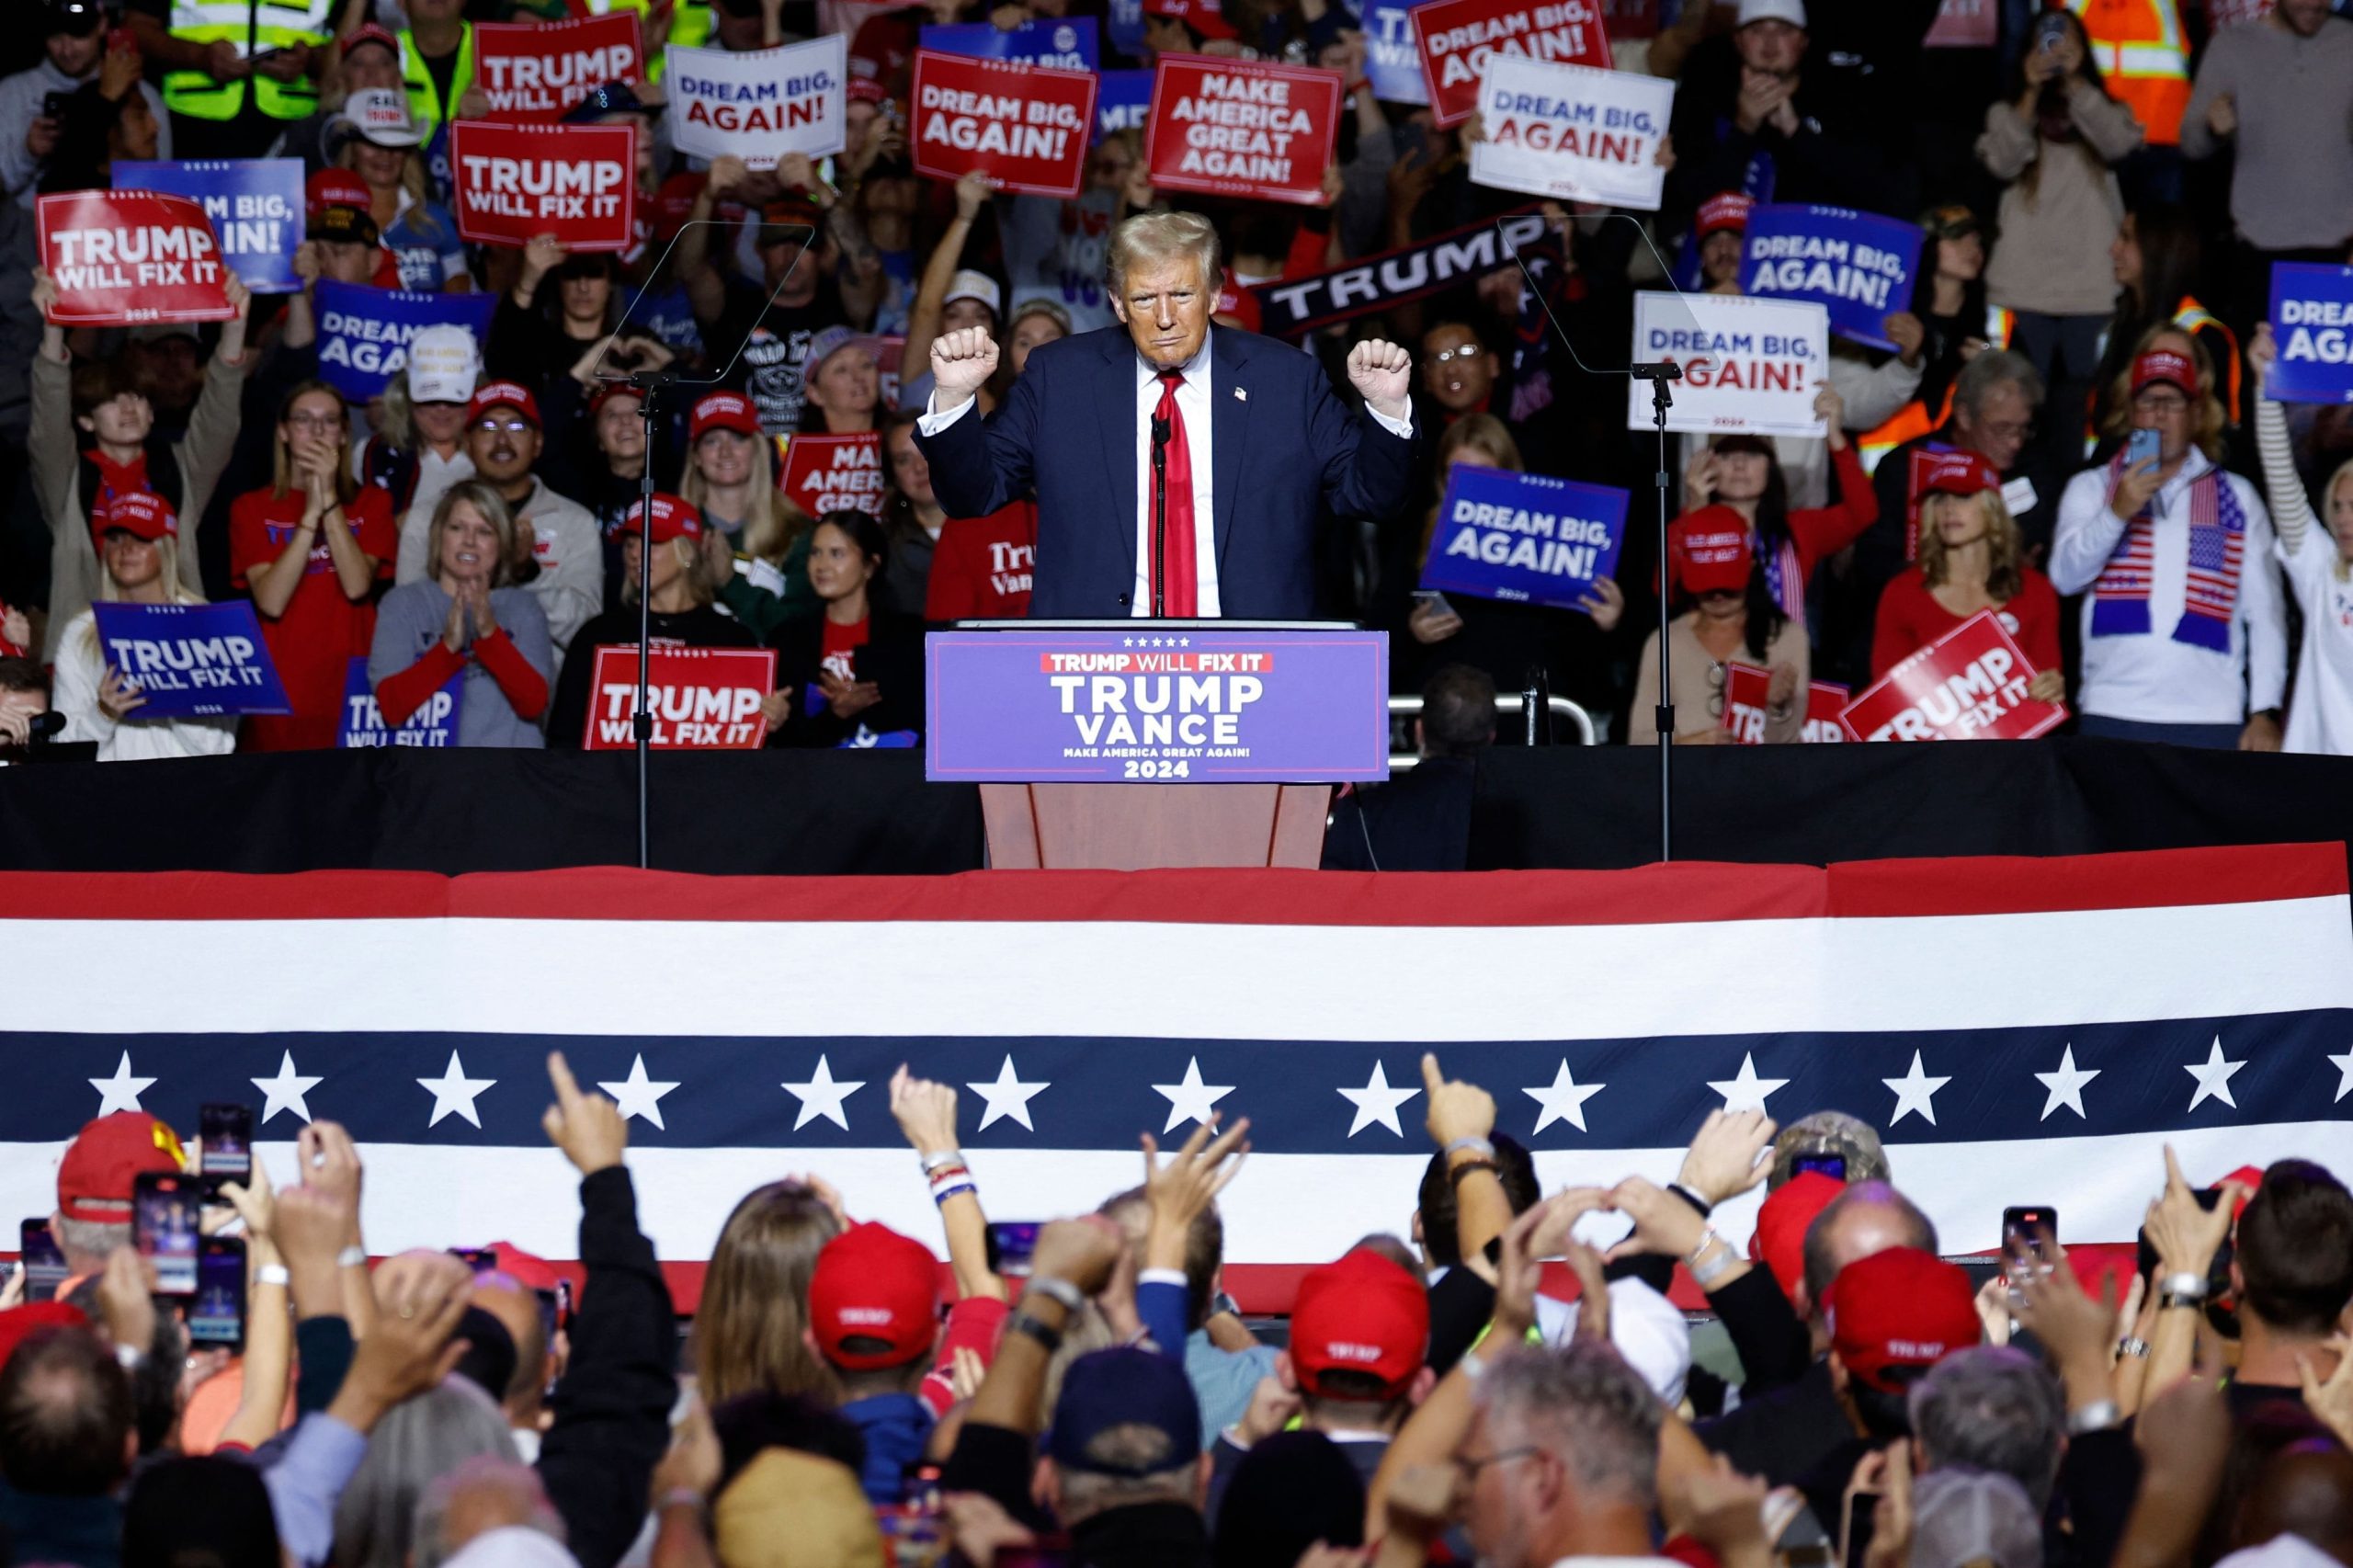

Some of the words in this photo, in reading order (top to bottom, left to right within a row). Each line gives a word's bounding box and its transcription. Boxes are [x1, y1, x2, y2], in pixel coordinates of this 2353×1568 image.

[1427, 10, 1531, 58] DREAM
[1532, 0, 1594, 30] BIG,
[483, 44, 634, 89] TRUMP
[486, 87, 556, 111] WILL
[680, 75, 778, 103] DREAM
[786, 70, 835, 97] BIG,
[1201, 73, 1290, 105] MAKE
[687, 95, 825, 133] AGAIN!
[922, 85, 1022, 121] DREAM
[1027, 100, 1083, 132] BIG,
[1170, 96, 1312, 134] AMERICA
[1494, 90, 1597, 126] DREAM
[1603, 106, 1658, 136] BIG,
[924, 111, 1068, 161] AGAIN!
[1186, 123, 1293, 157] GREAT
[1493, 118, 1643, 166] AGAIN!
[462, 154, 623, 196] TRUMP
[1179, 149, 1291, 183] AGAIN!
[235, 194, 294, 222] BIG,
[465, 189, 533, 218] WILL
[539, 196, 585, 219] FIX
[592, 195, 620, 218] IT
[51, 225, 213, 267] TRUMP
[223, 221, 282, 254] IN!
[55, 265, 132, 291] WILL
[139, 262, 187, 287] FIX
[192, 260, 218, 284] IT
[1271, 215, 1546, 321] TRUMP
[1750, 234, 1849, 262] DREAM
[1852, 246, 1906, 284] BIG,
[1750, 258, 1893, 310] AGAIN!
[2280, 300, 2353, 327] DRE
[319, 335, 408, 376] AGA
[1649, 328, 1752, 355] DREAM
[1762, 335, 1818, 362] BIG,
[831, 444, 881, 469] MA
[800, 469, 884, 493] AMER
[1452, 499, 1556, 539] DREAM
[1559, 517, 1612, 551] BIG,
[1446, 527, 1598, 581] AGAIN!
[990, 573, 1033, 597] Van
[108, 635, 256, 673] TRUMP
[1050, 653, 1131, 672] TRUMP
[1136, 653, 1192, 672] WILL
[1199, 653, 1236, 672] FIX
[1241, 653, 1264, 672] IT
[121, 671, 189, 691] WILL
[189, 666, 237, 689] FIX
[239, 665, 263, 686] IT
[1050, 676, 1264, 713] TRUMP
[348, 691, 453, 732] TRMP
[602, 683, 763, 724] TRUMP
[1959, 695, 2008, 739] FIX
[2000, 675, 2029, 708] IT
[428, 729, 449, 747] IT
[675, 722, 722, 745] FIX
[725, 722, 756, 744] IT
[1074, 713, 1240, 745] VANCE
[1063, 747, 1098, 758] MAKE
[1102, 747, 1159, 758] AMERICA
[1162, 747, 1203, 758] GREAT
[1206, 747, 1250, 758] AGAIN!
[1124, 760, 1190, 778] 2024
